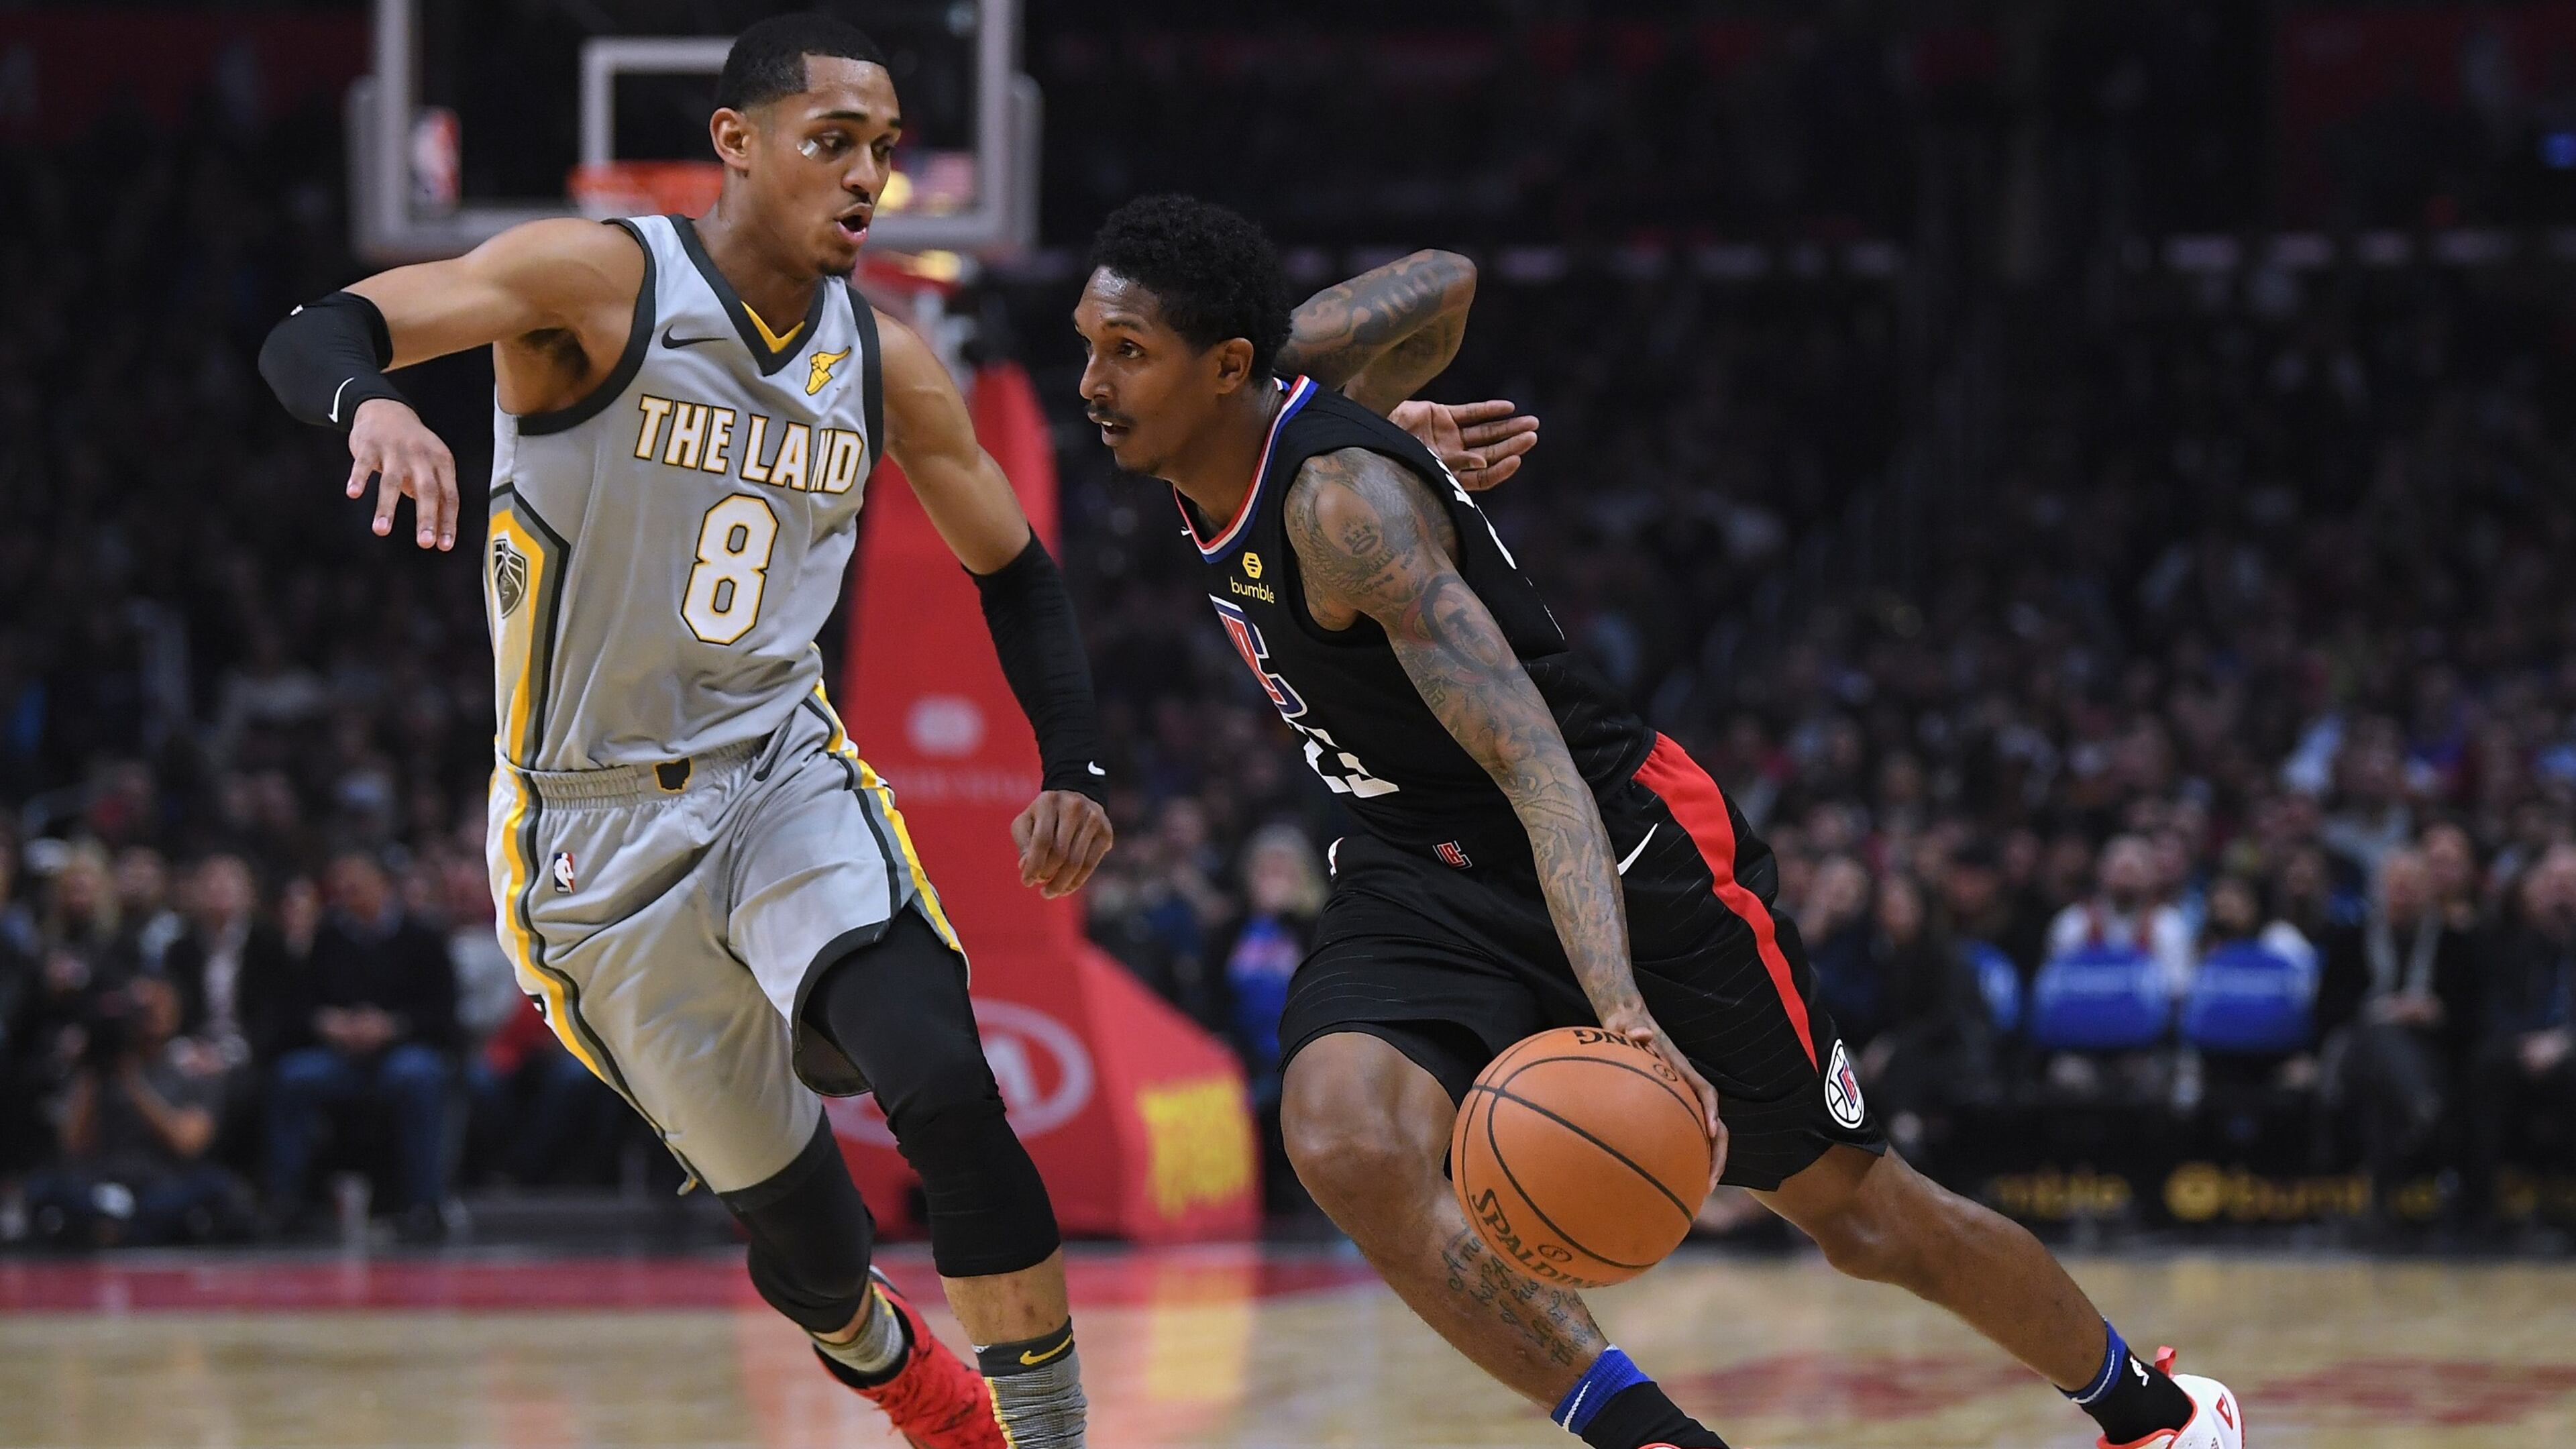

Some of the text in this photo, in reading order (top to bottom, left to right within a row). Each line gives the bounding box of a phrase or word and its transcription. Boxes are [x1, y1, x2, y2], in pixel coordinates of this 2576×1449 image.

[635, 394, 864, 495] THE LAND
[680, 492, 780, 646] 8
[1230, 576, 1275, 604] bumble
